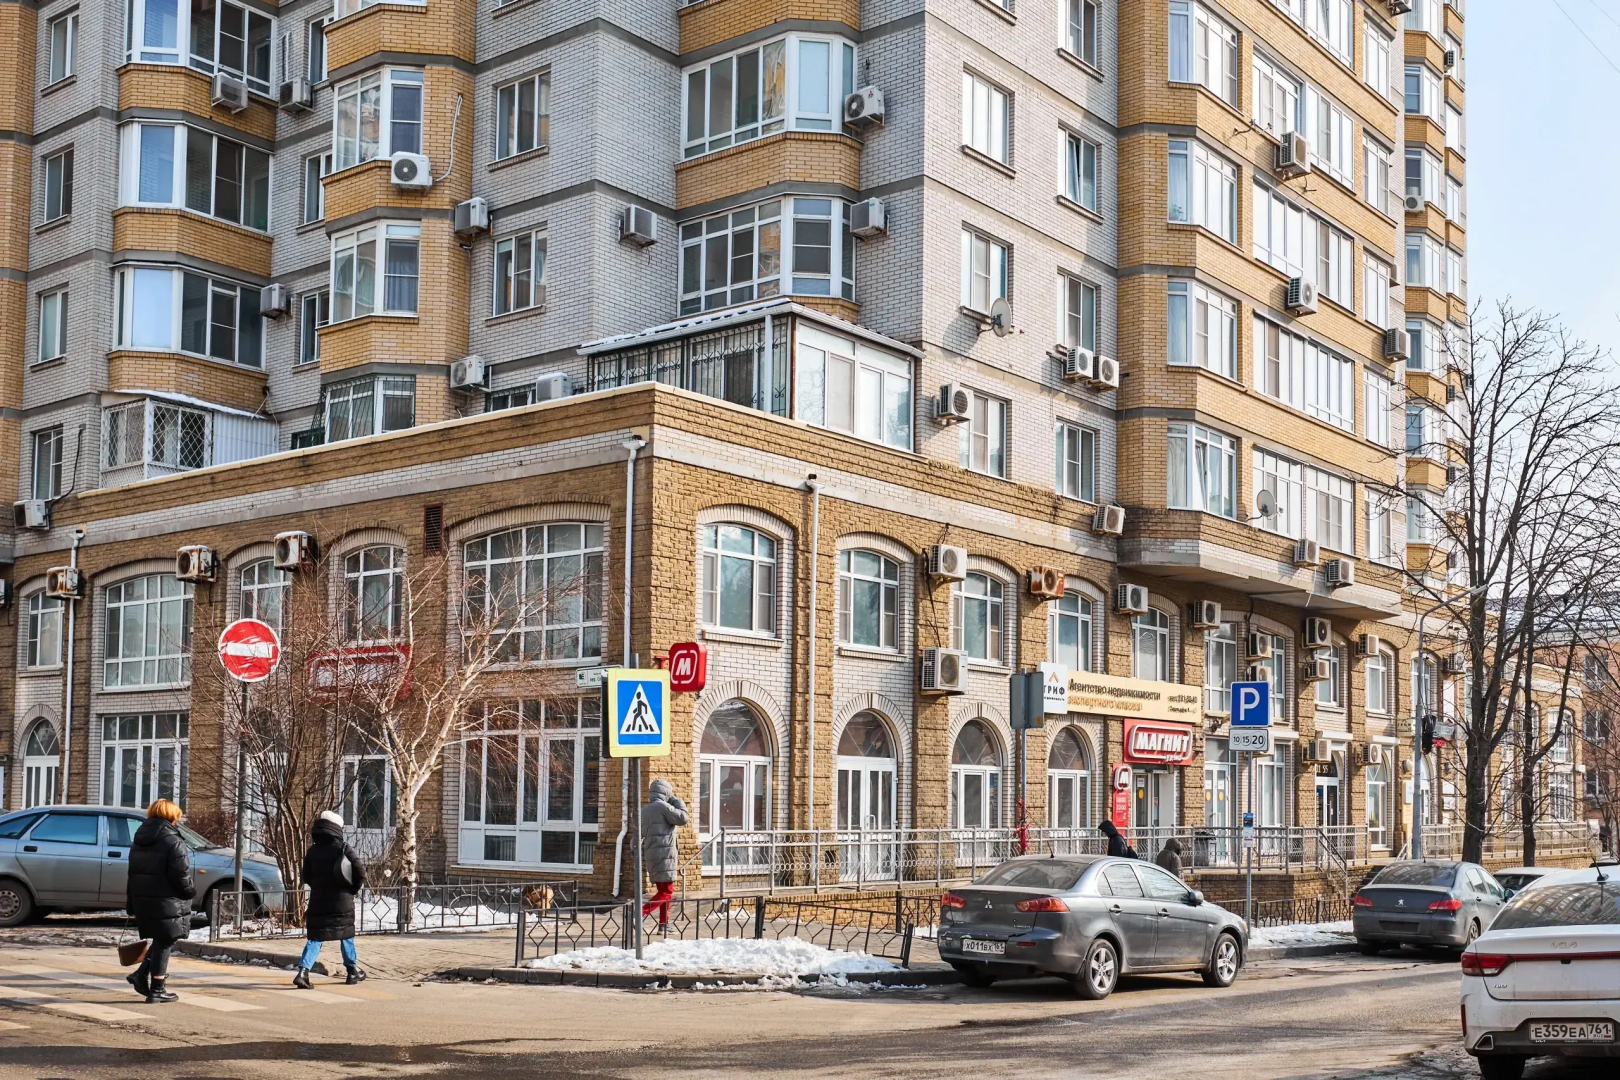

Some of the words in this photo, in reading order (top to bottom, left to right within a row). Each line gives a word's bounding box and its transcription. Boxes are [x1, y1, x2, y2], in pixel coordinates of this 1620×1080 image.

[1069, 678, 1107, 695] Агентство
[1108, 686, 1161, 701] недвижимости
[1240, 687, 1260, 721] P
[1136, 731, 1190, 753] МАГНИТ
[1252, 735, 1264, 745] 20
[1534, 1024, 1587, 1038] Е359ЕА
[1588, 1024, 1609, 1034] 761
